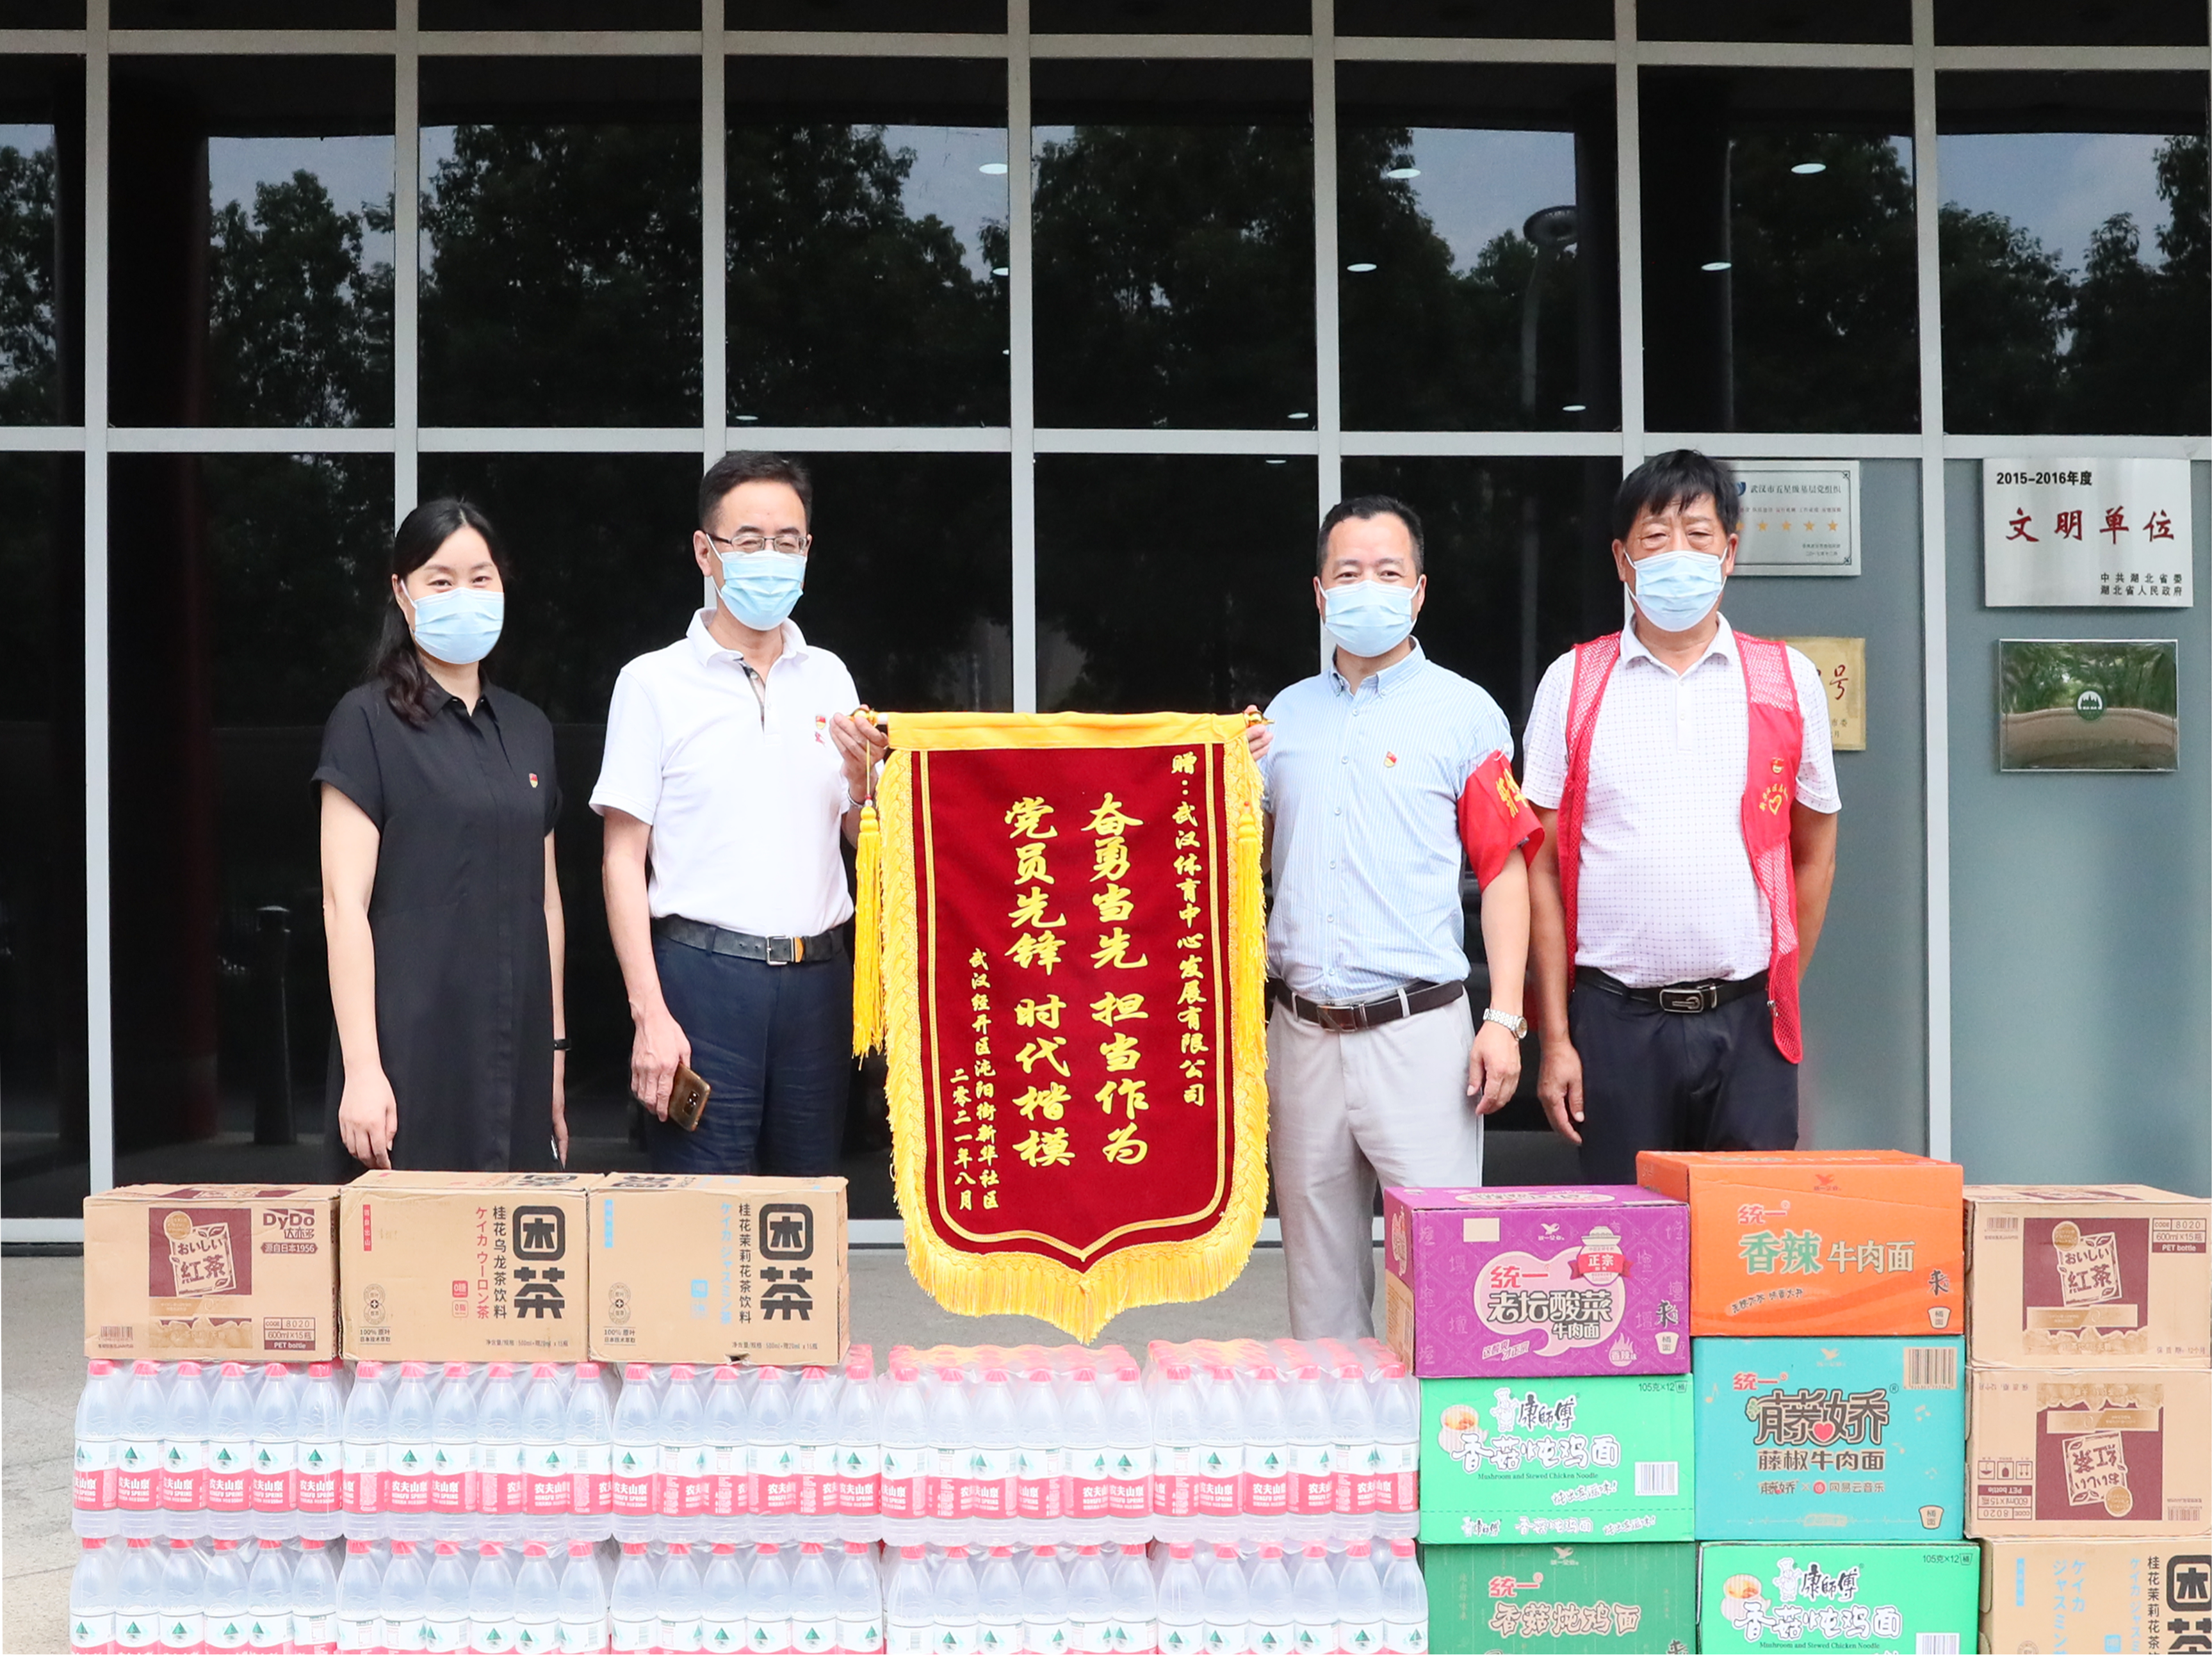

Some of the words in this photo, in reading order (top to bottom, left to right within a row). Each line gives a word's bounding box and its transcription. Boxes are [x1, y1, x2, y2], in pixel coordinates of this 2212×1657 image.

[1996, 471, 2092, 485] 2015-2016年度
[1750, 485, 1842, 494] 武汉市五星级基层党组织
[2006, 506, 2175, 543] 文明单位
[2101, 573, 2183, 583] 中共湖北省委
[2101, 585, 2183, 596] 湖北省人民政府
[1004, 795, 1066, 976] 党员先锋
[1081, 792, 1148, 970] 奋勇当先
[1011, 994, 1076, 1168] 时代楷模
[1089, 991, 1150, 1166] 担当作为
[950, 1068, 977, 1211] 二零二一年八月
[263, 1209, 315, 1229] DyDo
[1738, 1204, 1787, 1225] 统一
[2175, 1220, 2201, 1229] 8020
[177, 1238, 224, 1255] おいしい
[265, 1243, 314, 1253] 源自日本1956
[2065, 1246, 2110, 1265] おいしい
[181, 1254, 225, 1284] 紅茶
[492, 1206, 507, 1319] 桂花乌龙茶饮料
[512, 1205, 566, 1319] 困茶
[739, 1203, 751, 1324] 桂花茉莉花茶饮料
[759, 1203, 814, 1321] 困茶
[1588, 1254, 1614, 1267] 正宗
[1490, 1265, 1549, 1289] 统一
[2068, 1264, 2112, 1294] 紅茶
[1487, 1290, 1613, 1323] 老坛酸菜
[1552, 1322, 1600, 1339] 牛肉面
[1733, 1372, 1778, 1391] 统一
[1451, 1433, 1621, 1473] 香菇炖鸡面
[1757, 1450, 1885, 1471] 藤椒牛肉面
[209, 1478, 244, 1491] 农夫山泉
[300, 1480, 335, 1492] 农夫山泉
[614, 1483, 648, 1495] 农夫山泉
[1110, 1484, 1144, 1496] 农夫山泉
[1829, 1482, 1885, 1492] 网易云音乐
[1489, 1576, 1540, 1597] 统一
[2053, 1560, 2067, 1654] ジャスミン
[2148, 1556, 2160, 1654] 桂花茉莉花茶
[1489, 1601, 1641, 1638] 香菇炖鸡面
[1734, 1602, 1903, 1641] 香菇炖鸡面
